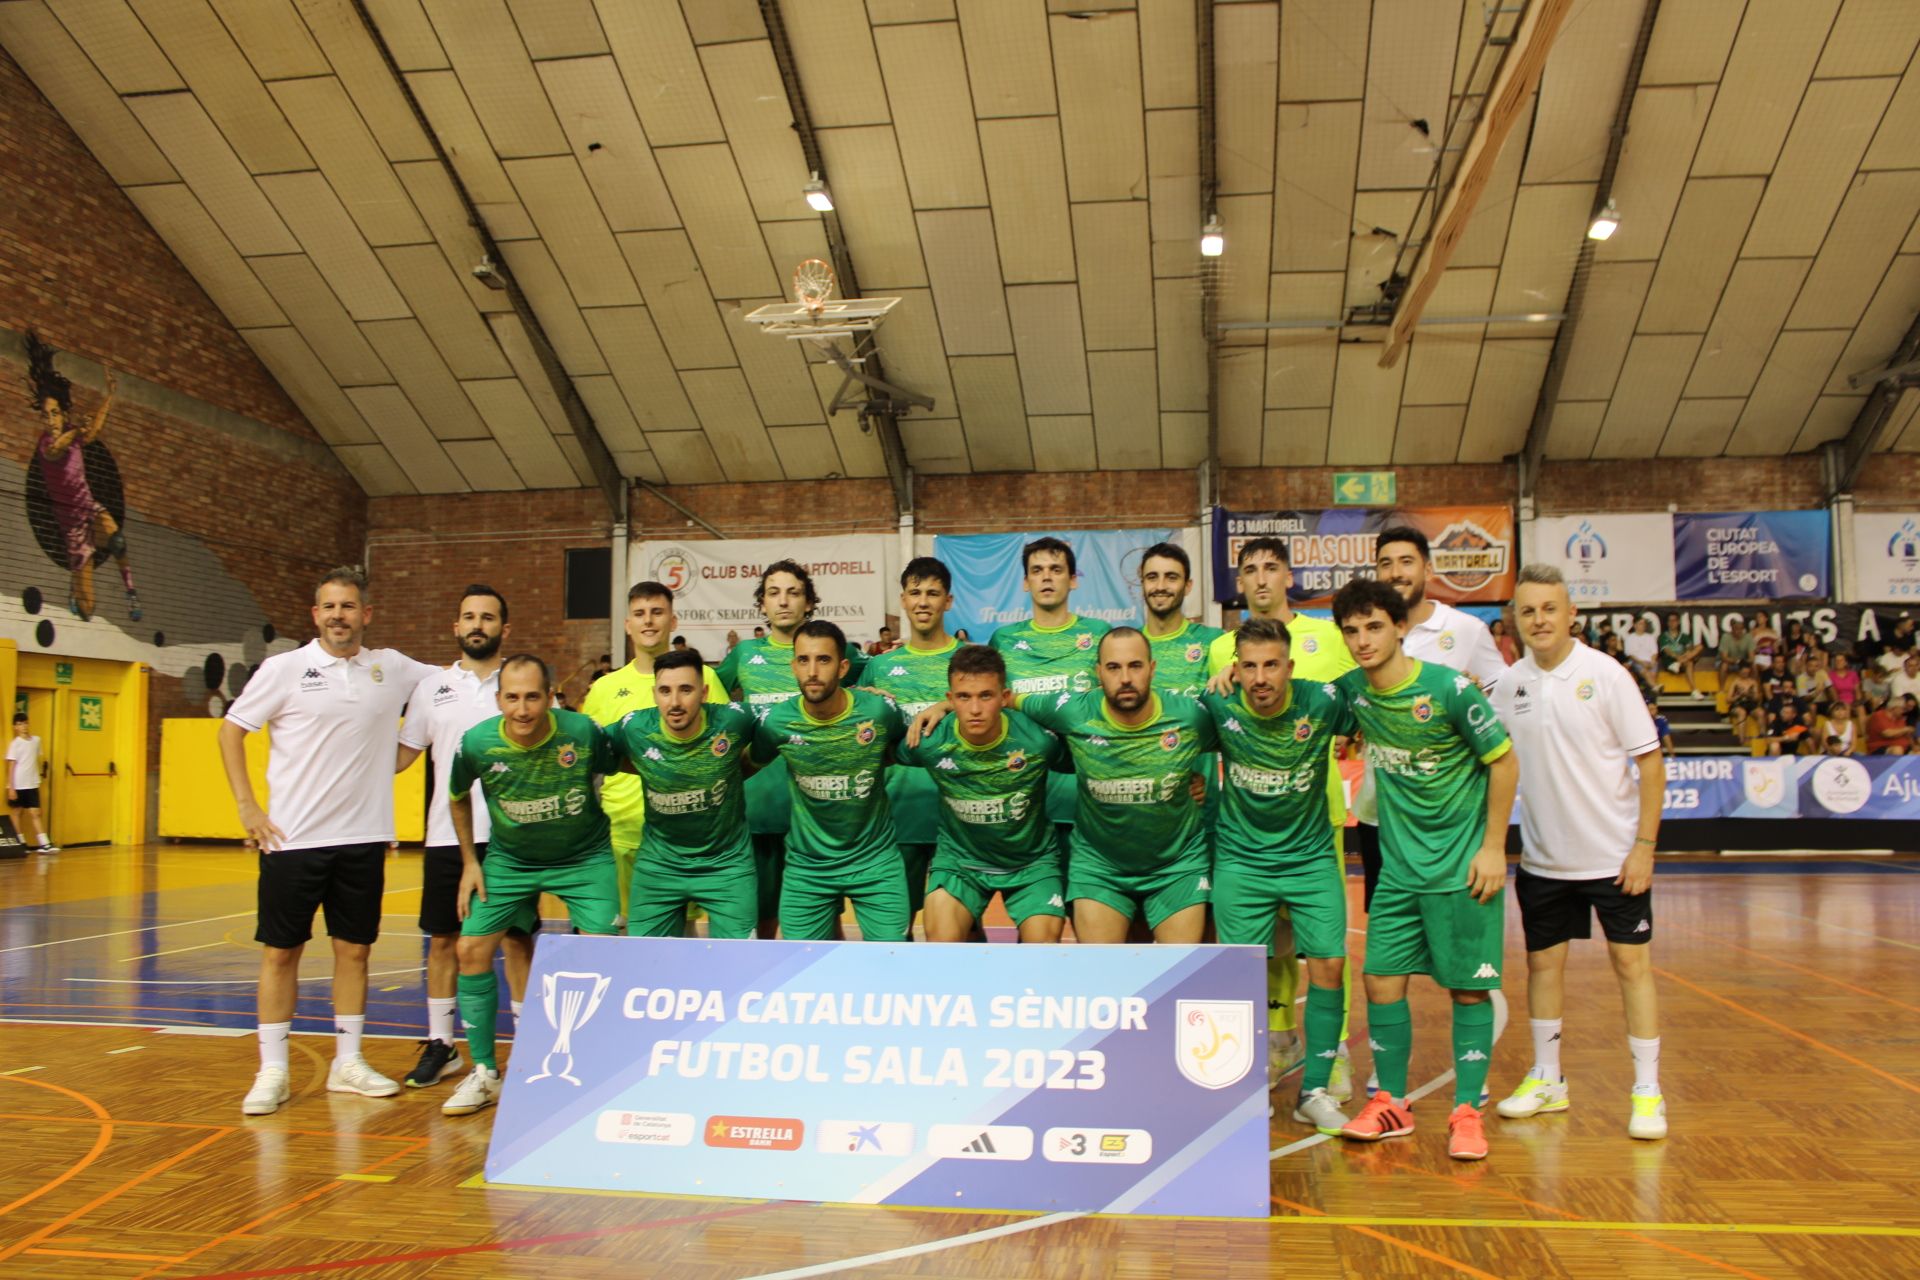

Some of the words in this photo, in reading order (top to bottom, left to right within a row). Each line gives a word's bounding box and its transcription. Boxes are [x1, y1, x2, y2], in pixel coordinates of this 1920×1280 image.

[1246, 519, 1306, 533] MARTORELL
[1707, 528, 1759, 541] CIUTAT
[1291, 533, 1378, 568] BASQUE
[1708, 541, 1779, 555] EUROPEA
[702, 566, 737, 579] CLUB
[741, 565, 764, 578] SAL
[799, 561, 875, 576] ARTORELL
[1708, 557, 1729, 569] DE
[1303, 571, 1331, 590] DES
[1709, 569, 1778, 584] L'ESPORT
[1890, 584, 1920, 594] 202
[676, 609, 714, 622] SFORÇ
[815, 605, 865, 616] MPENSA
[1857, 608, 1882, 642] A
[1664, 757, 1734, 780] ÈNIOR
[1662, 788, 1699, 809] 23
[623, 987, 726, 1022] COPA
[737, 991, 977, 1028] CATALUNYA
[989, 988, 1148, 1030] SÈNIOR
[648, 1040, 829, 1083] FUTBOL
[843, 1045, 969, 1087] SALA
[983, 1048, 1106, 1090] 2023
[730, 1126, 793, 1141] ESTRELLA
[1071, 1134, 1087, 1156] 3
